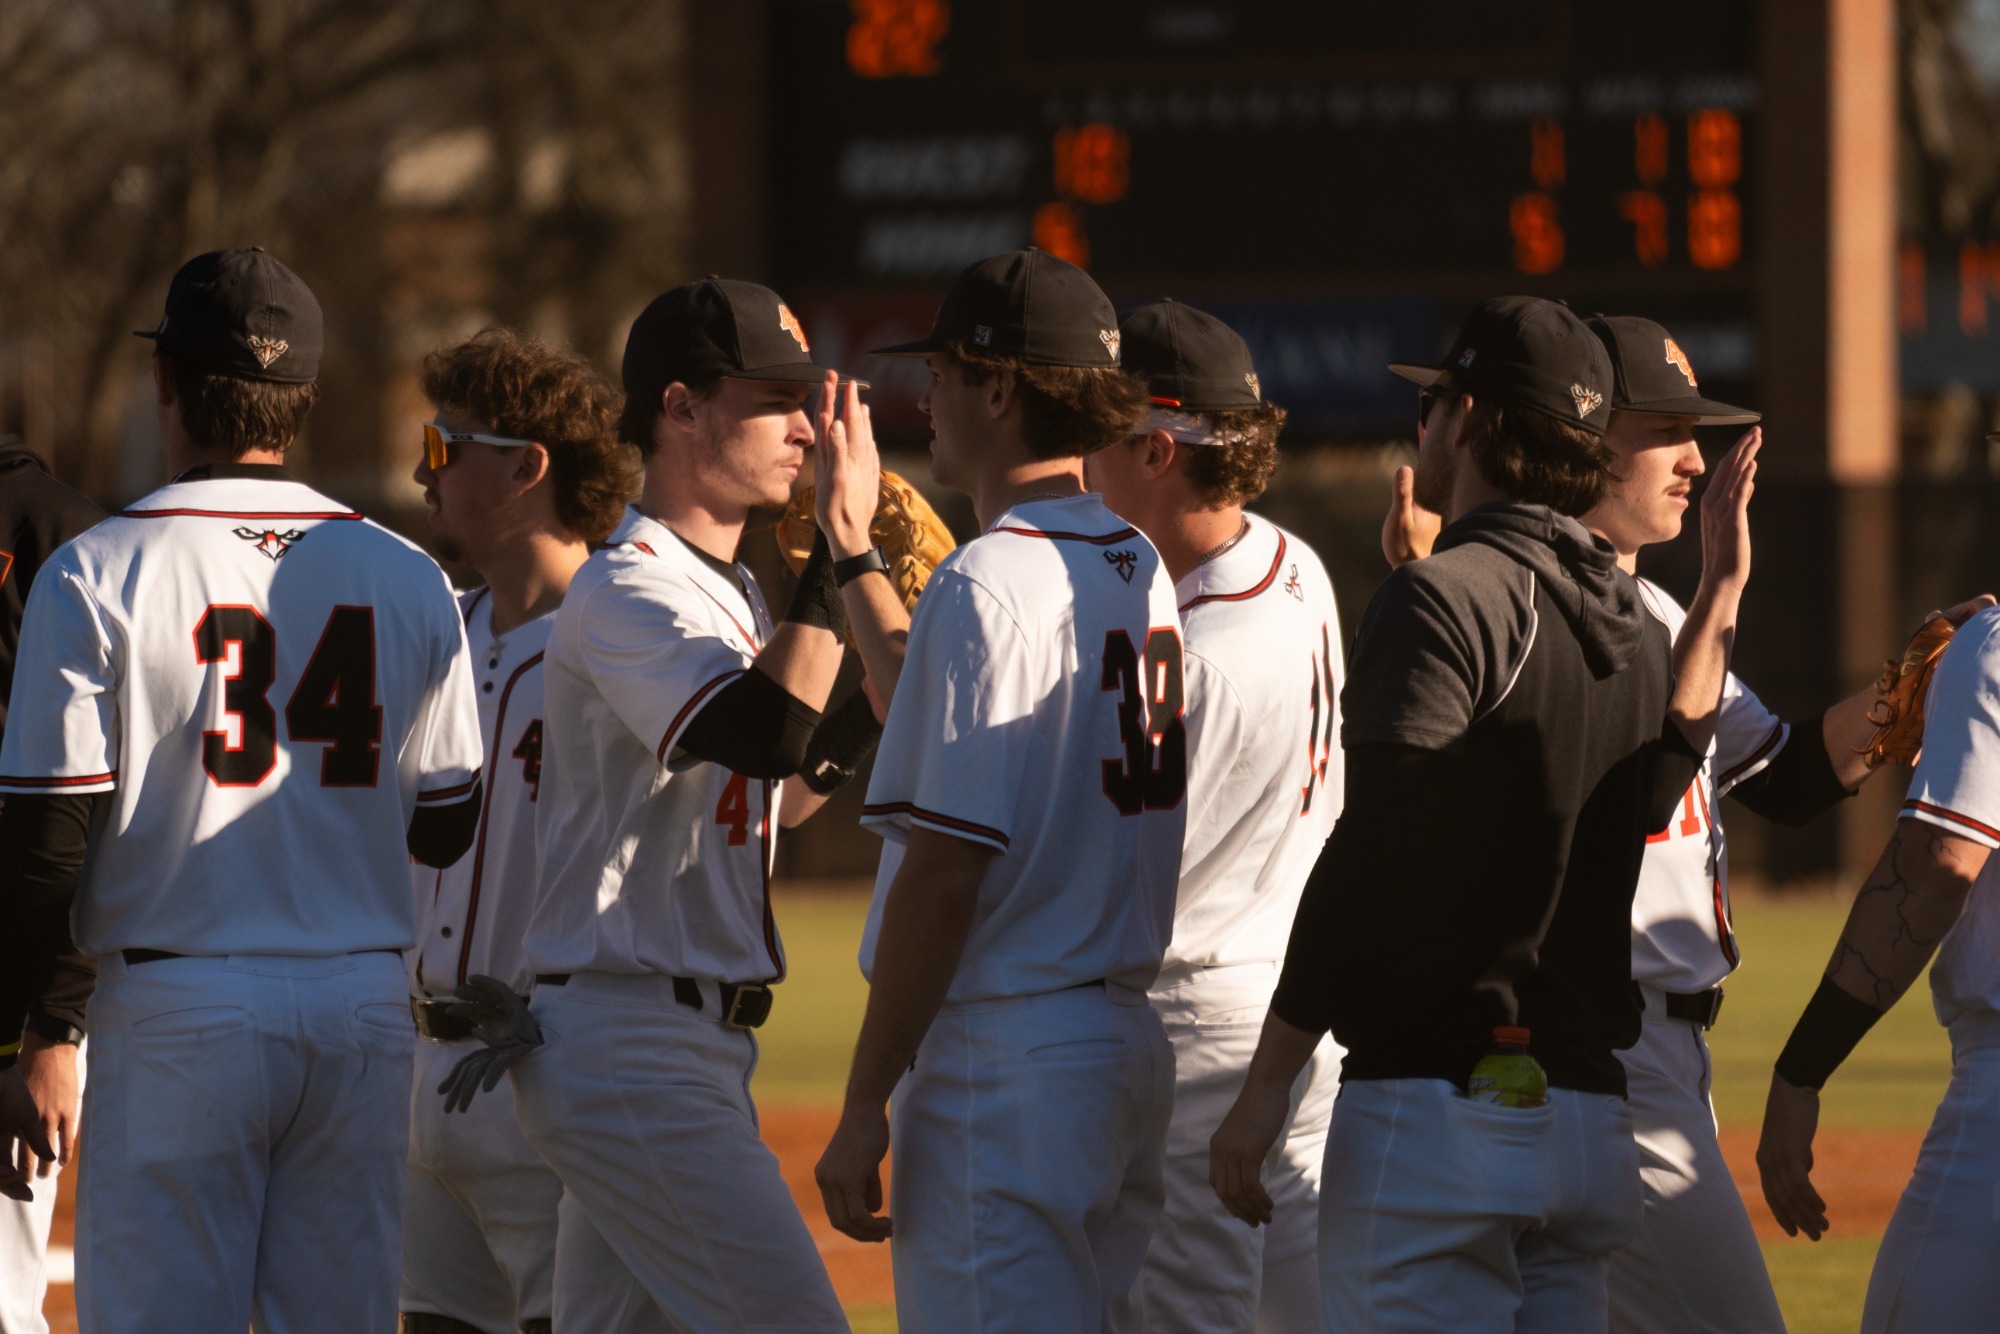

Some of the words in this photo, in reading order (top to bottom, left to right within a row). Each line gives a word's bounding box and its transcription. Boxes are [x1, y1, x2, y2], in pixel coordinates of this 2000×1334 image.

[192, 603, 383, 788] 34
[1101, 625, 1186, 817] 38
[714, 771, 750, 846] 4
